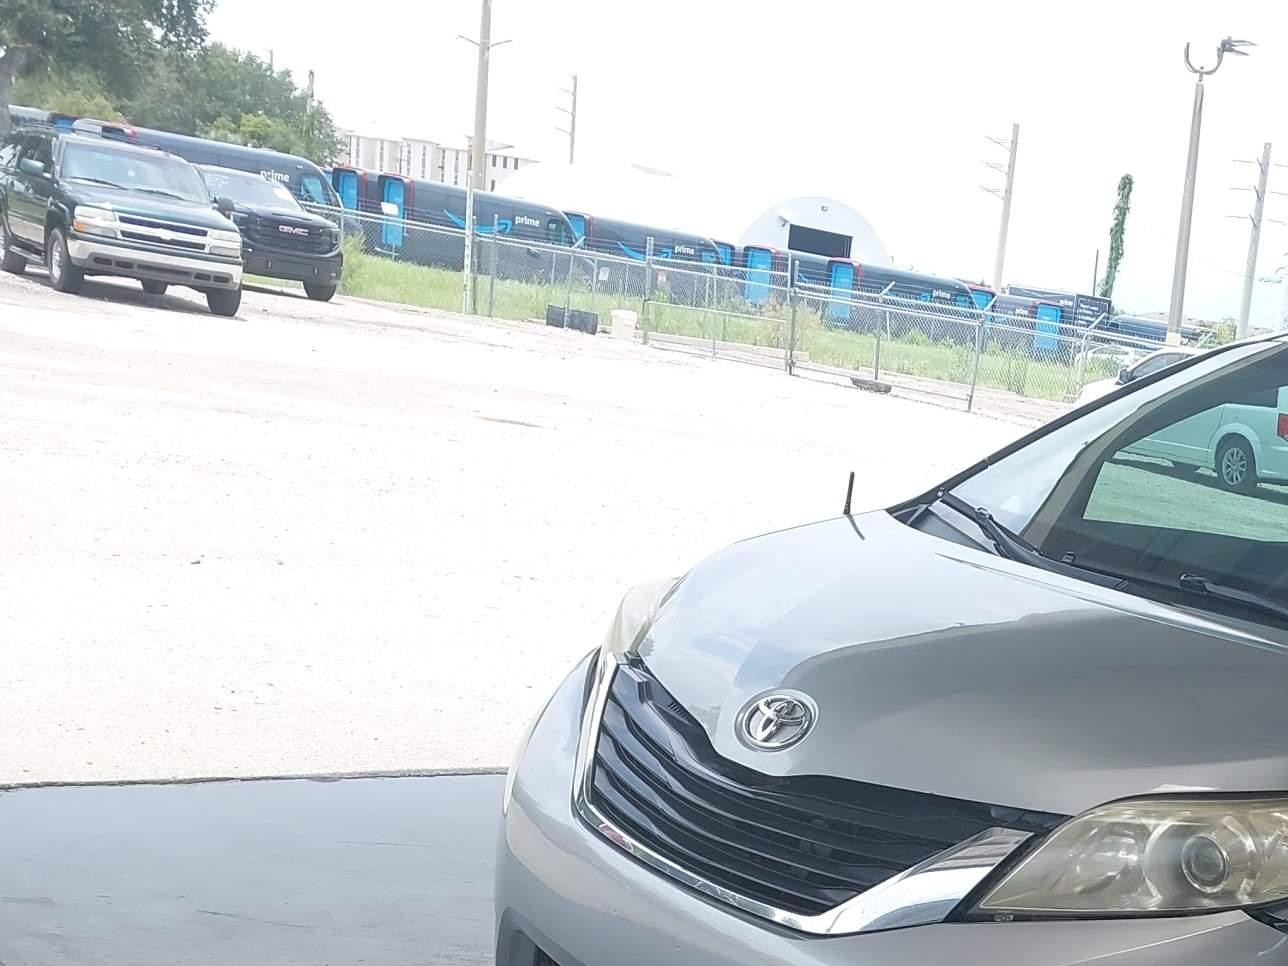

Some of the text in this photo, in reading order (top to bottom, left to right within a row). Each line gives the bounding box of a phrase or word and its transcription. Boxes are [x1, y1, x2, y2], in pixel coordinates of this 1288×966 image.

[514, 215, 540, 227] prime
[278, 224, 310, 236] GMC
[674, 244, 695, 255] prime
